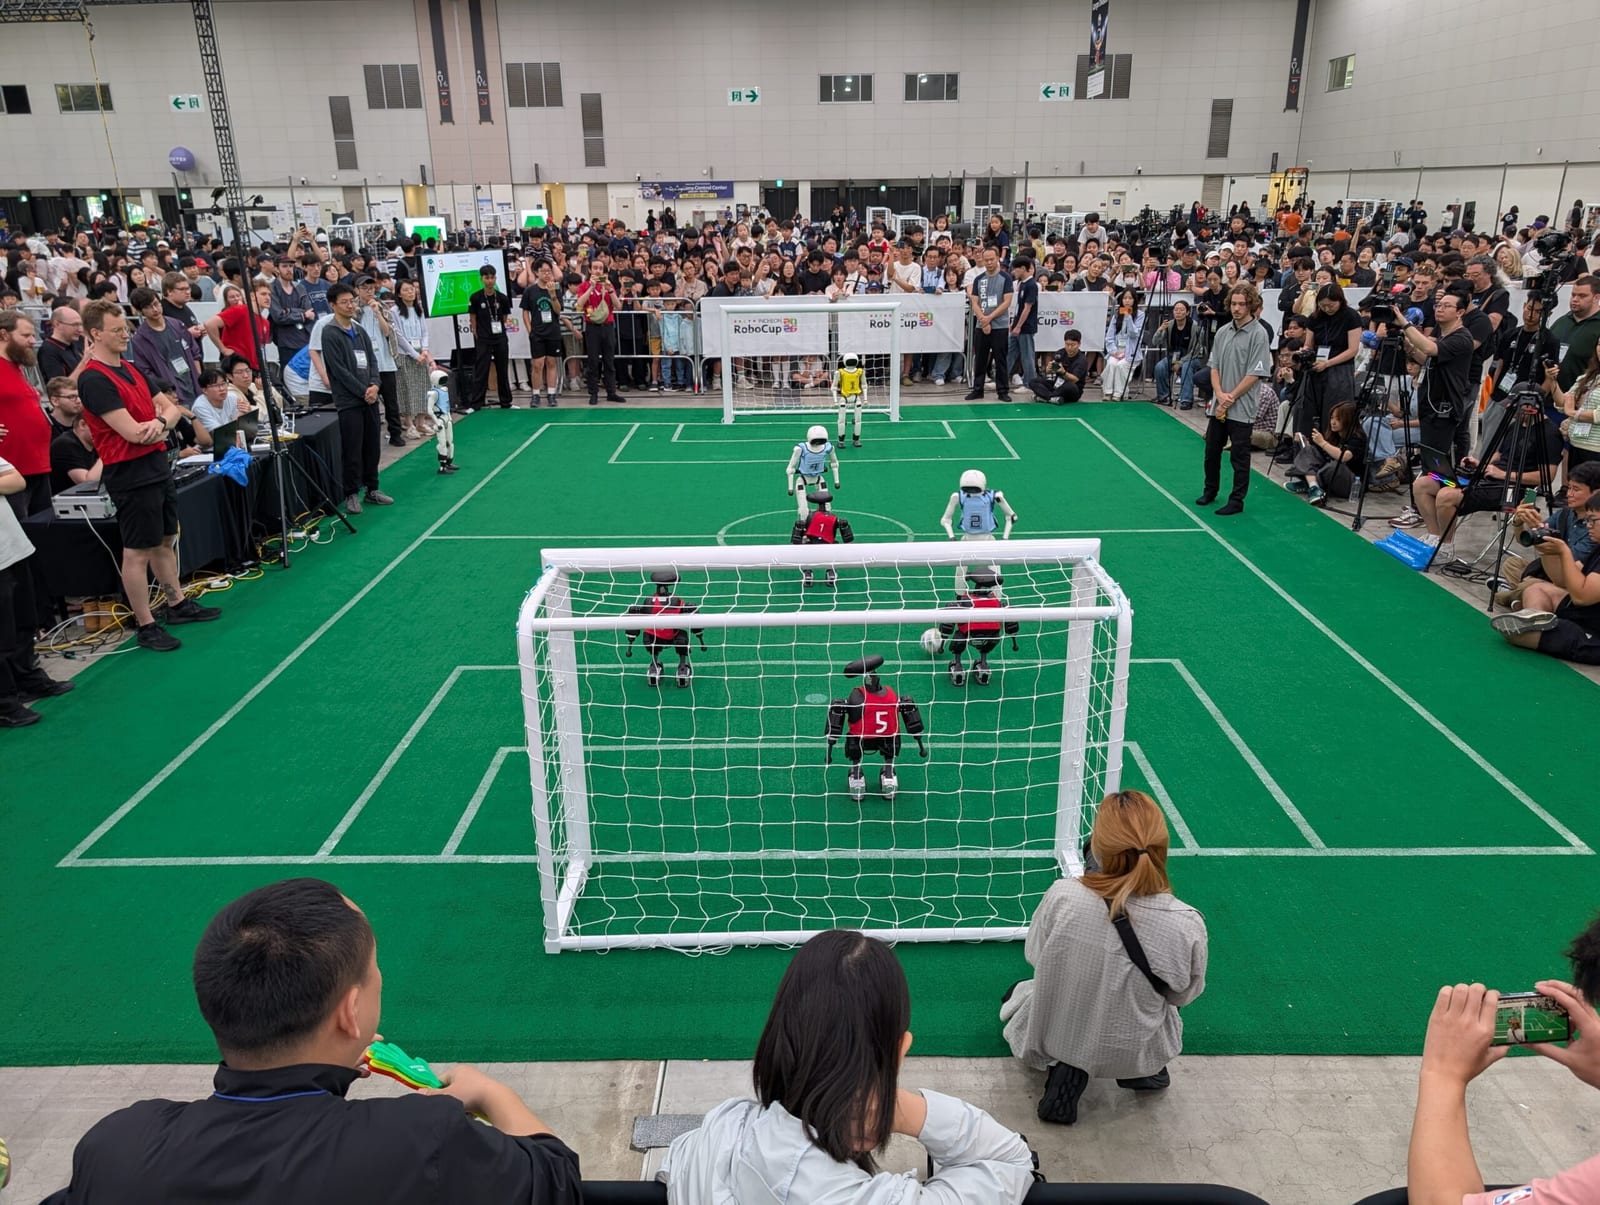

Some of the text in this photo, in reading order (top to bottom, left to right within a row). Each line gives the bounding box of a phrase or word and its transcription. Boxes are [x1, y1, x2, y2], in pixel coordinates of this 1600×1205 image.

[438, 259, 444, 268] 3
[483, 255, 490, 264] 5
[733, 324, 782, 335] RoboCup
[970, 514, 981, 528] 2
[875, 711, 888, 734] 5
